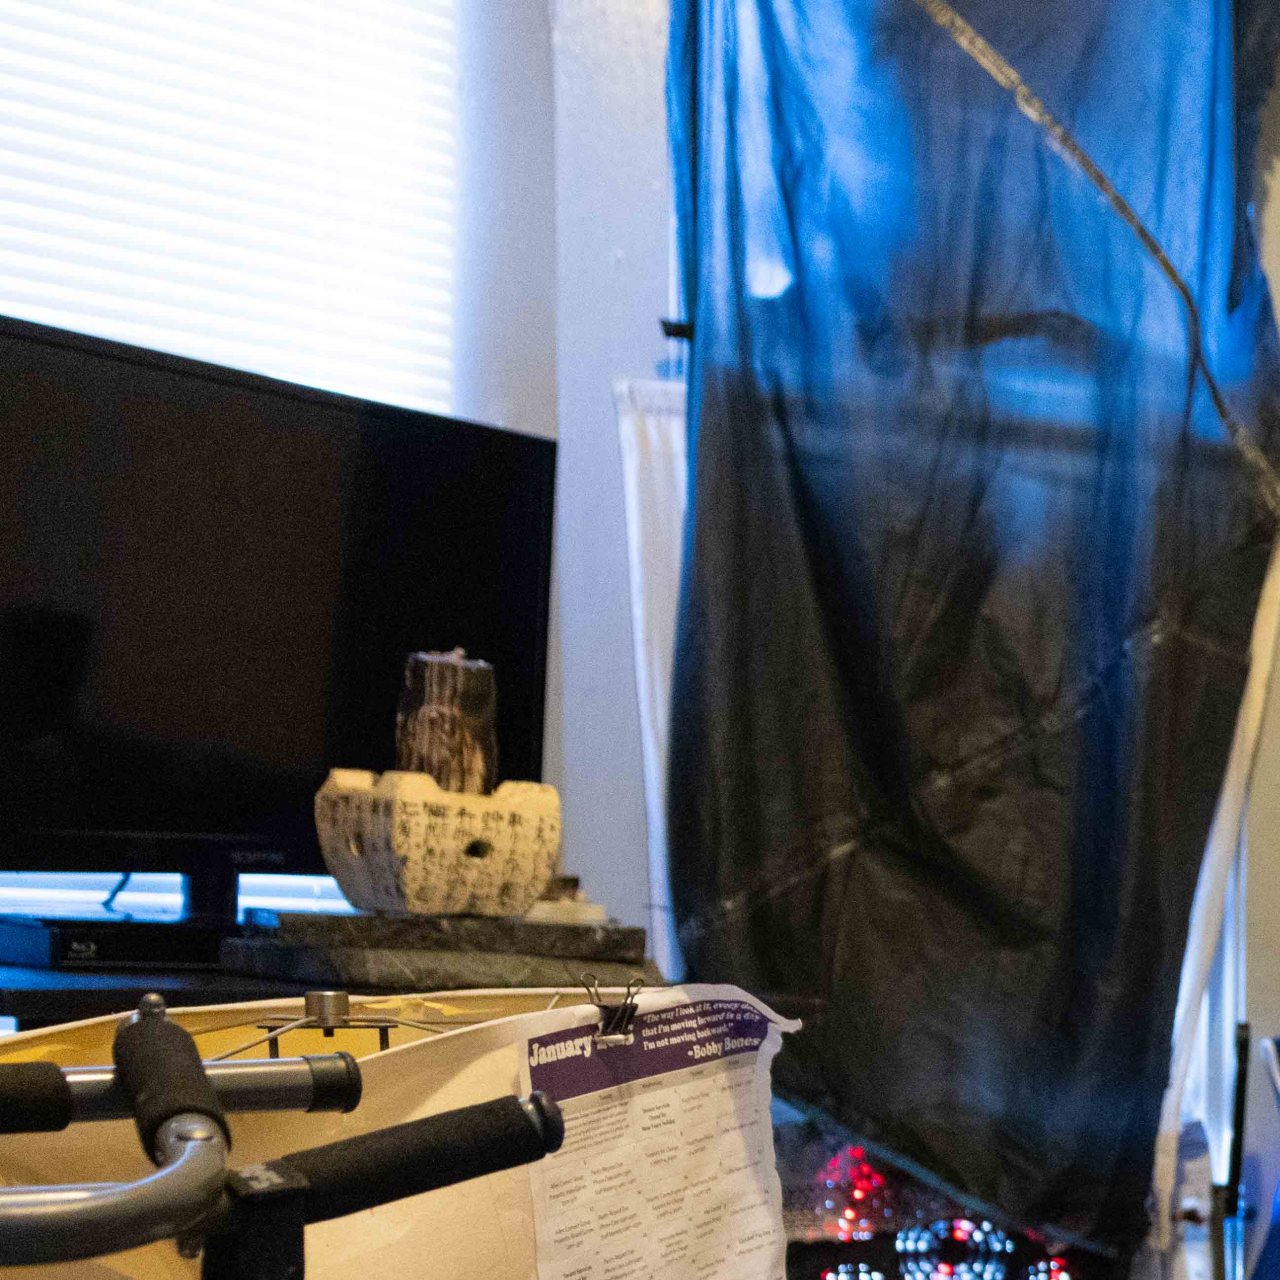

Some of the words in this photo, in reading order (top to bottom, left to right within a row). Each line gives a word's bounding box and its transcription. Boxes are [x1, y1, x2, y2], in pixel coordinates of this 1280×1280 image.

[660, 1011, 675, 1020] way
[680, 1005, 695, 1015] look
[713, 1002, 740, 1011] every
[642, 1026, 657, 1037] that
[658, 1024, 670, 1034] I'm
[671, 1019, 697, 1031] moving
[697, 1012, 726, 1025] forward
[643, 1041, 656, 1050] I'm
[656, 1037, 669, 1047] not
[670, 1032, 697, 1045] moving
[724, 1036, 761, 1050] Bones
[530, 1035, 592, 1067] January
